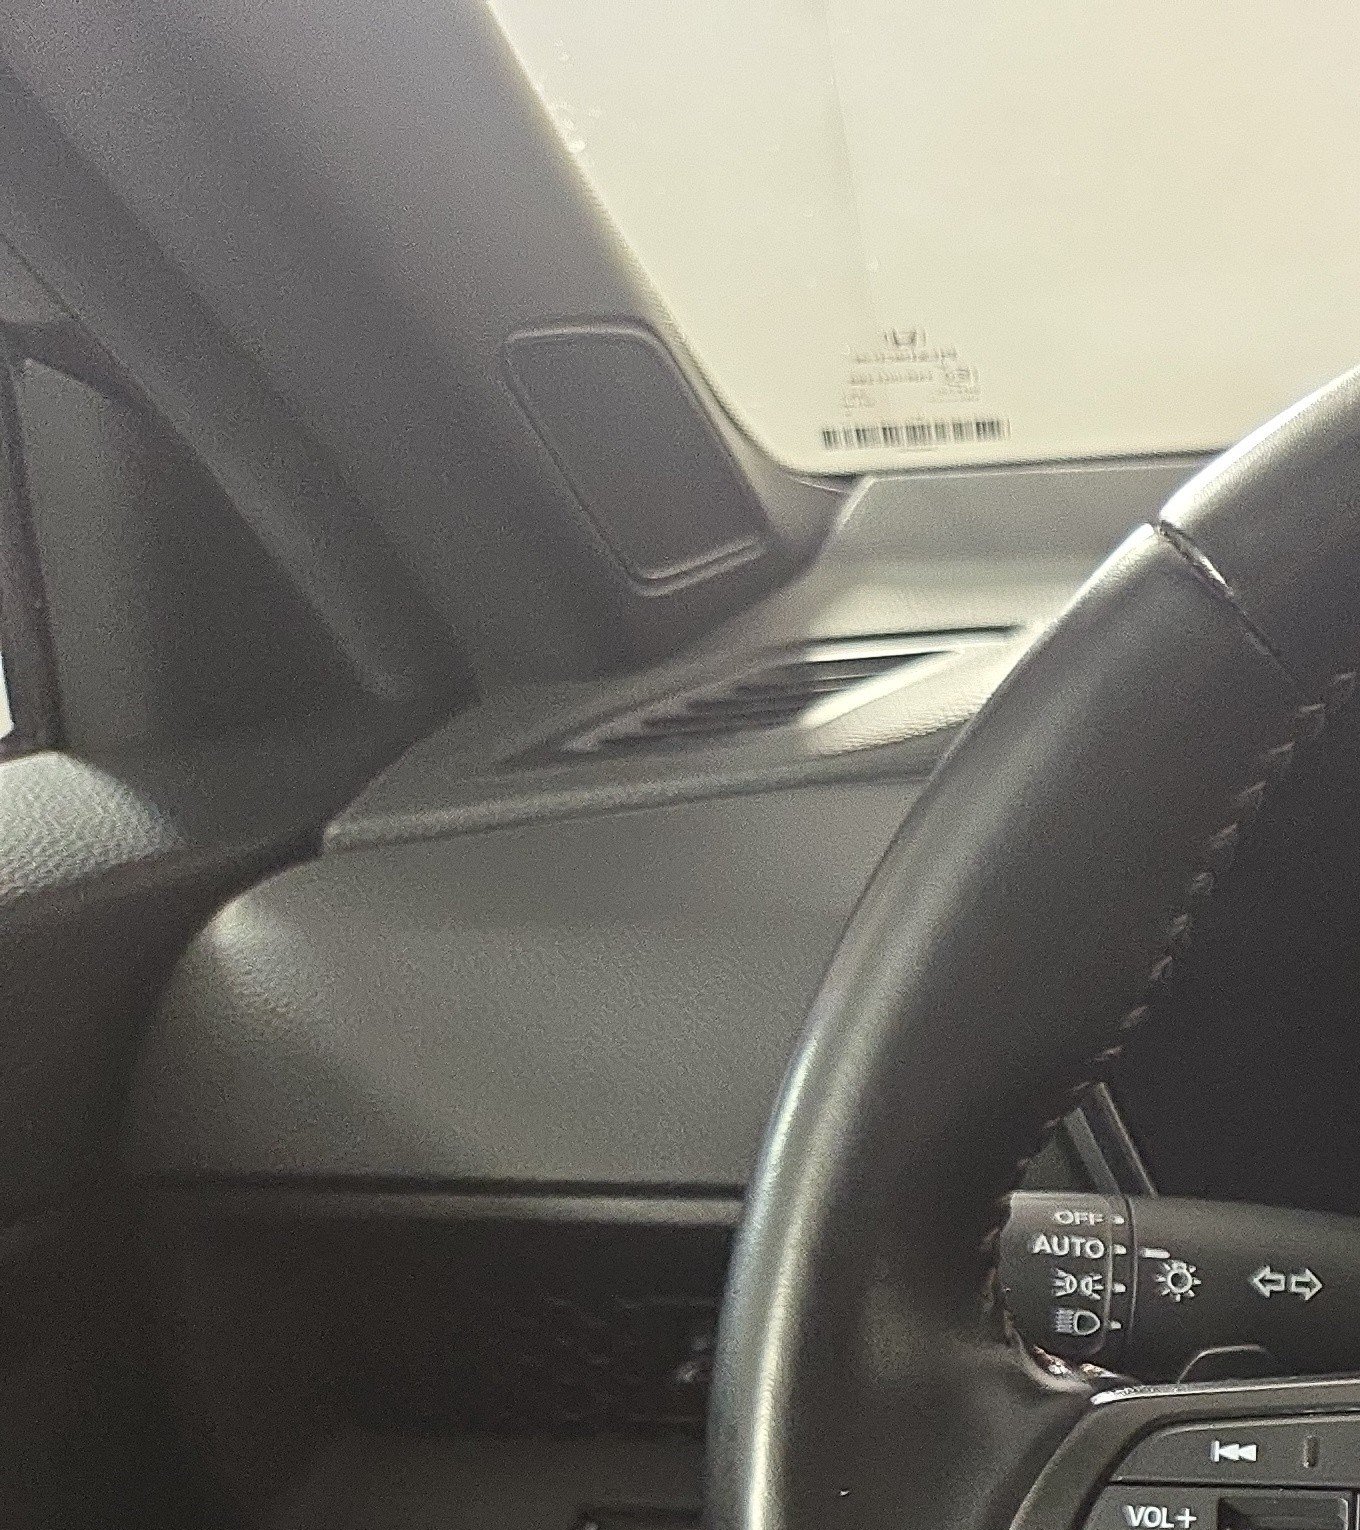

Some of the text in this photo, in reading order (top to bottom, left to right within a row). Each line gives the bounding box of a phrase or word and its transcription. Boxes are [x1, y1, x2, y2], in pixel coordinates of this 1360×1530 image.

[1054, 1211, 1104, 1225] OFF
[1032, 1234, 1106, 1259] AUTO
[1125, 1505, 1197, 1529] VOL+
